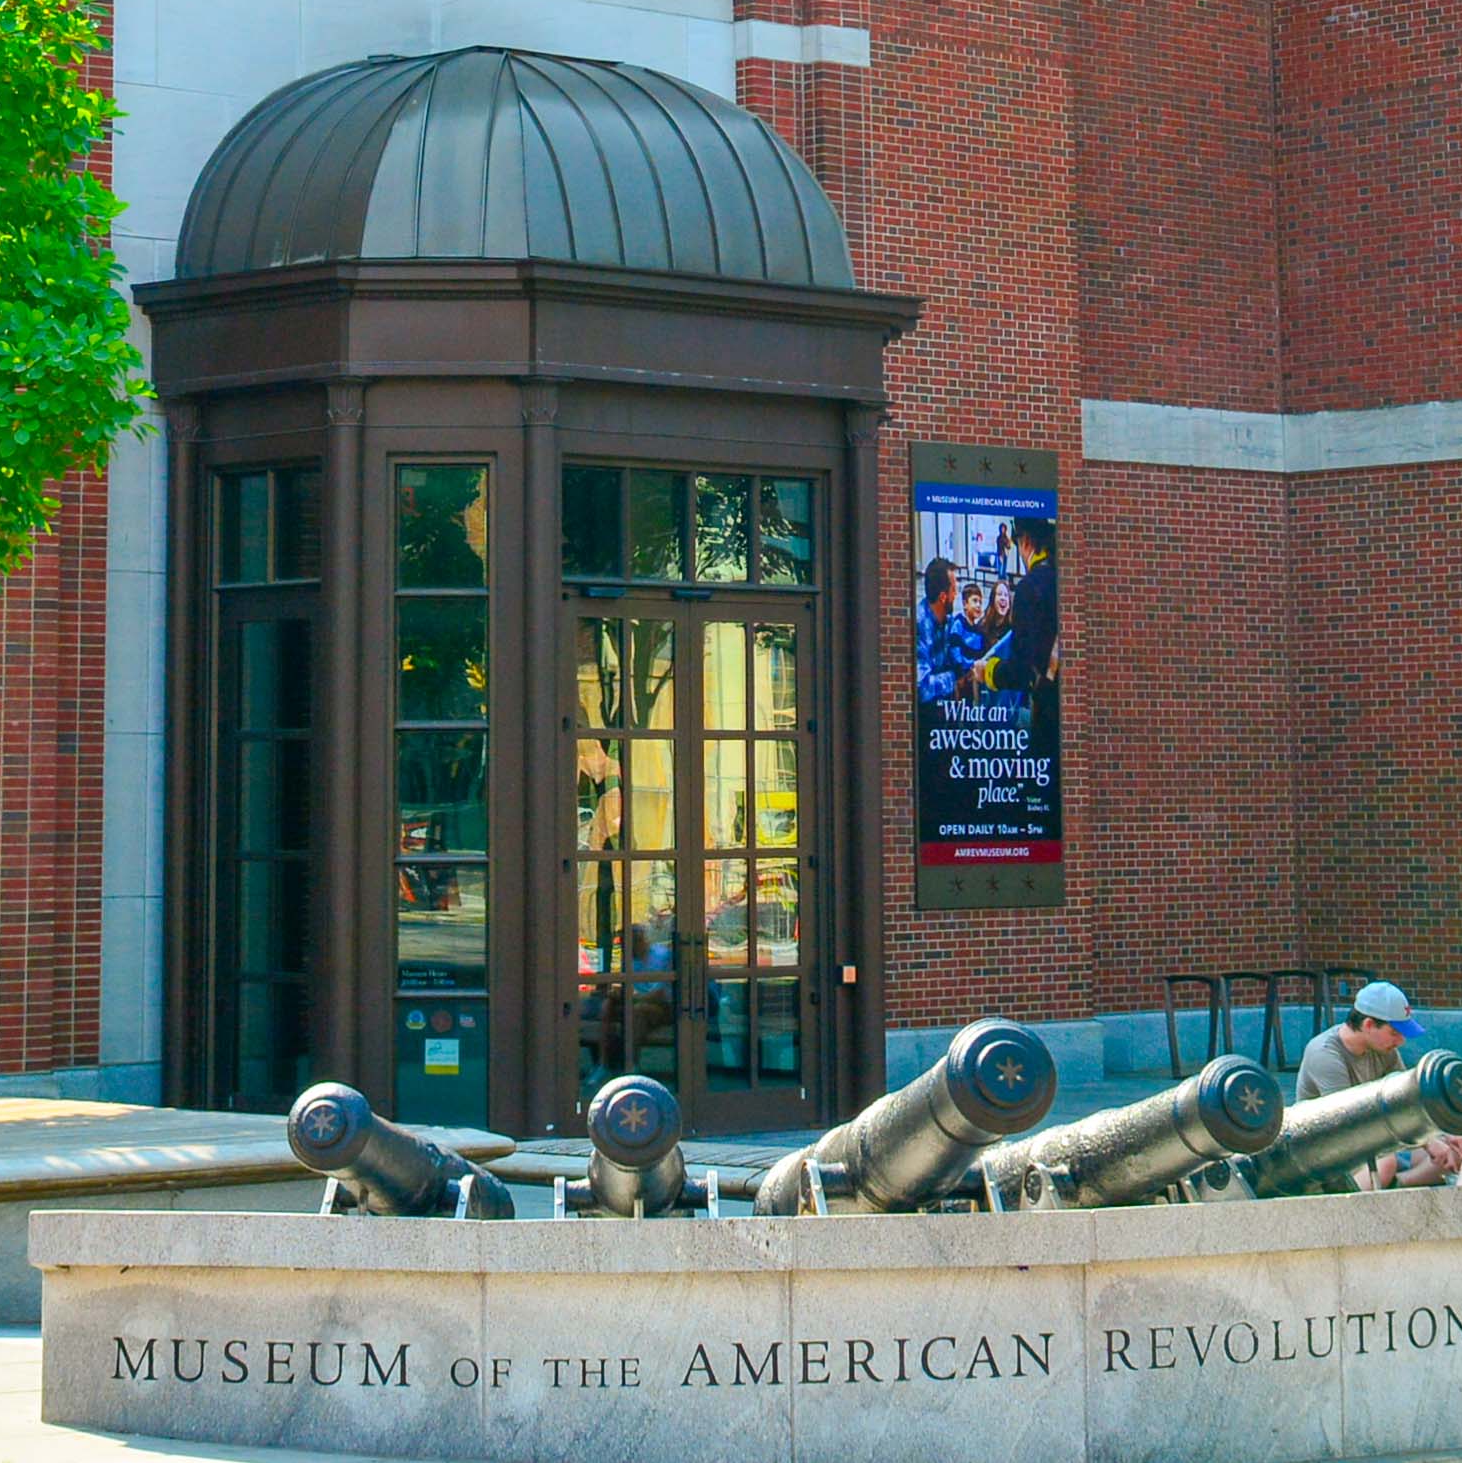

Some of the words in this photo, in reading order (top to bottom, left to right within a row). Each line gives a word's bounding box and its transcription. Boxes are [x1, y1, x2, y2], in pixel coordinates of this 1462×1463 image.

[988, 706, 1008, 723] an
[929, 728, 1029, 750] awesome
[949, 755, 966, 779] &
[968, 750, 1051, 786] moving
[939, 824, 966, 835] OPEN
[968, 824, 994, 835] DAILY
[954, 847, 1030, 858] AMREVMUSEUM.ORG
[112, 1336, 412, 1388] MUSEUM
[450, 1357, 513, 1388] OF
[543, 1357, 642, 1388] THE
[681, 1333, 1054, 1387] AMERICAN
